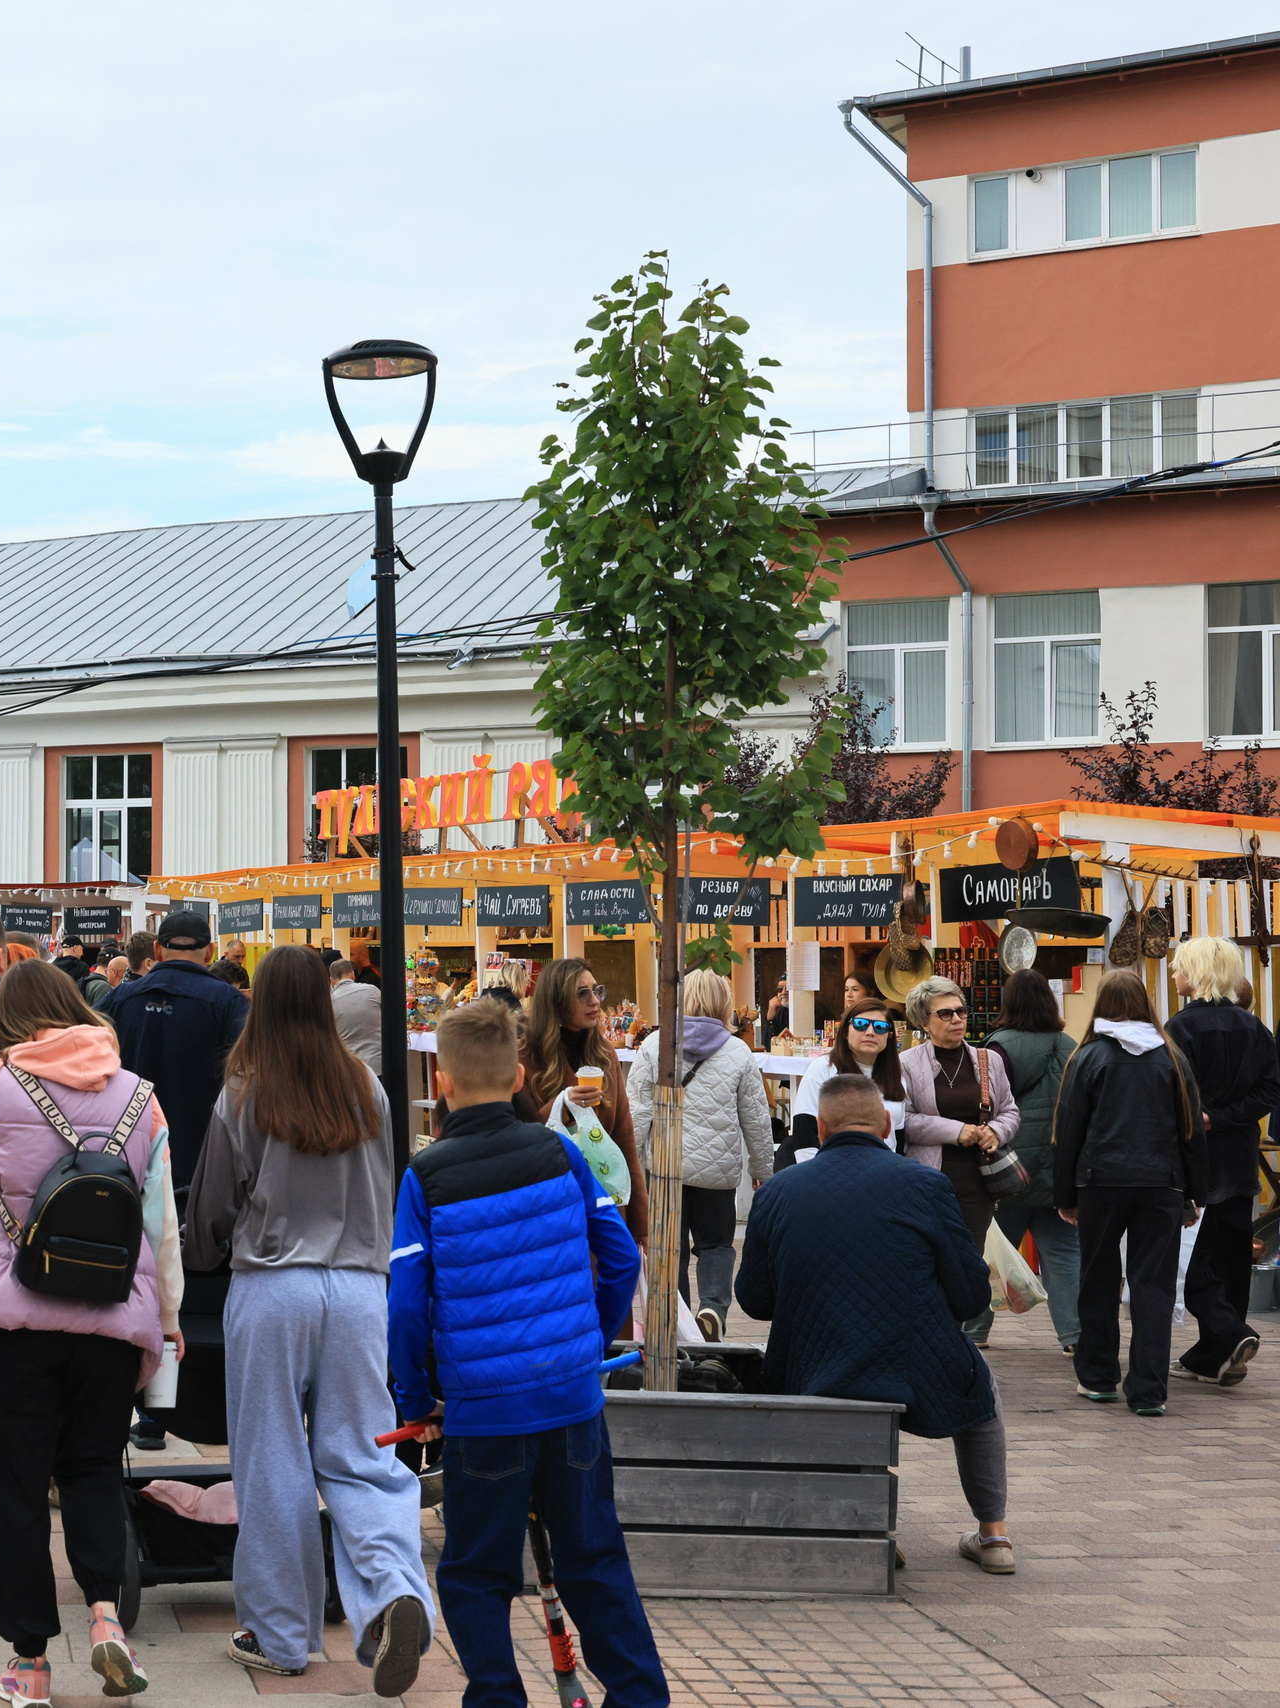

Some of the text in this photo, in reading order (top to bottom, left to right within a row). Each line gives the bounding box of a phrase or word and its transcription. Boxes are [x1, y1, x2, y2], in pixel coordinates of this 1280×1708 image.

[316, 753, 496, 855] ТУЛСКИЙ
[813, 877, 893, 893] ВКУСНЫЙ САХАР
[580, 887, 635, 901] СЛАДОСТИ
